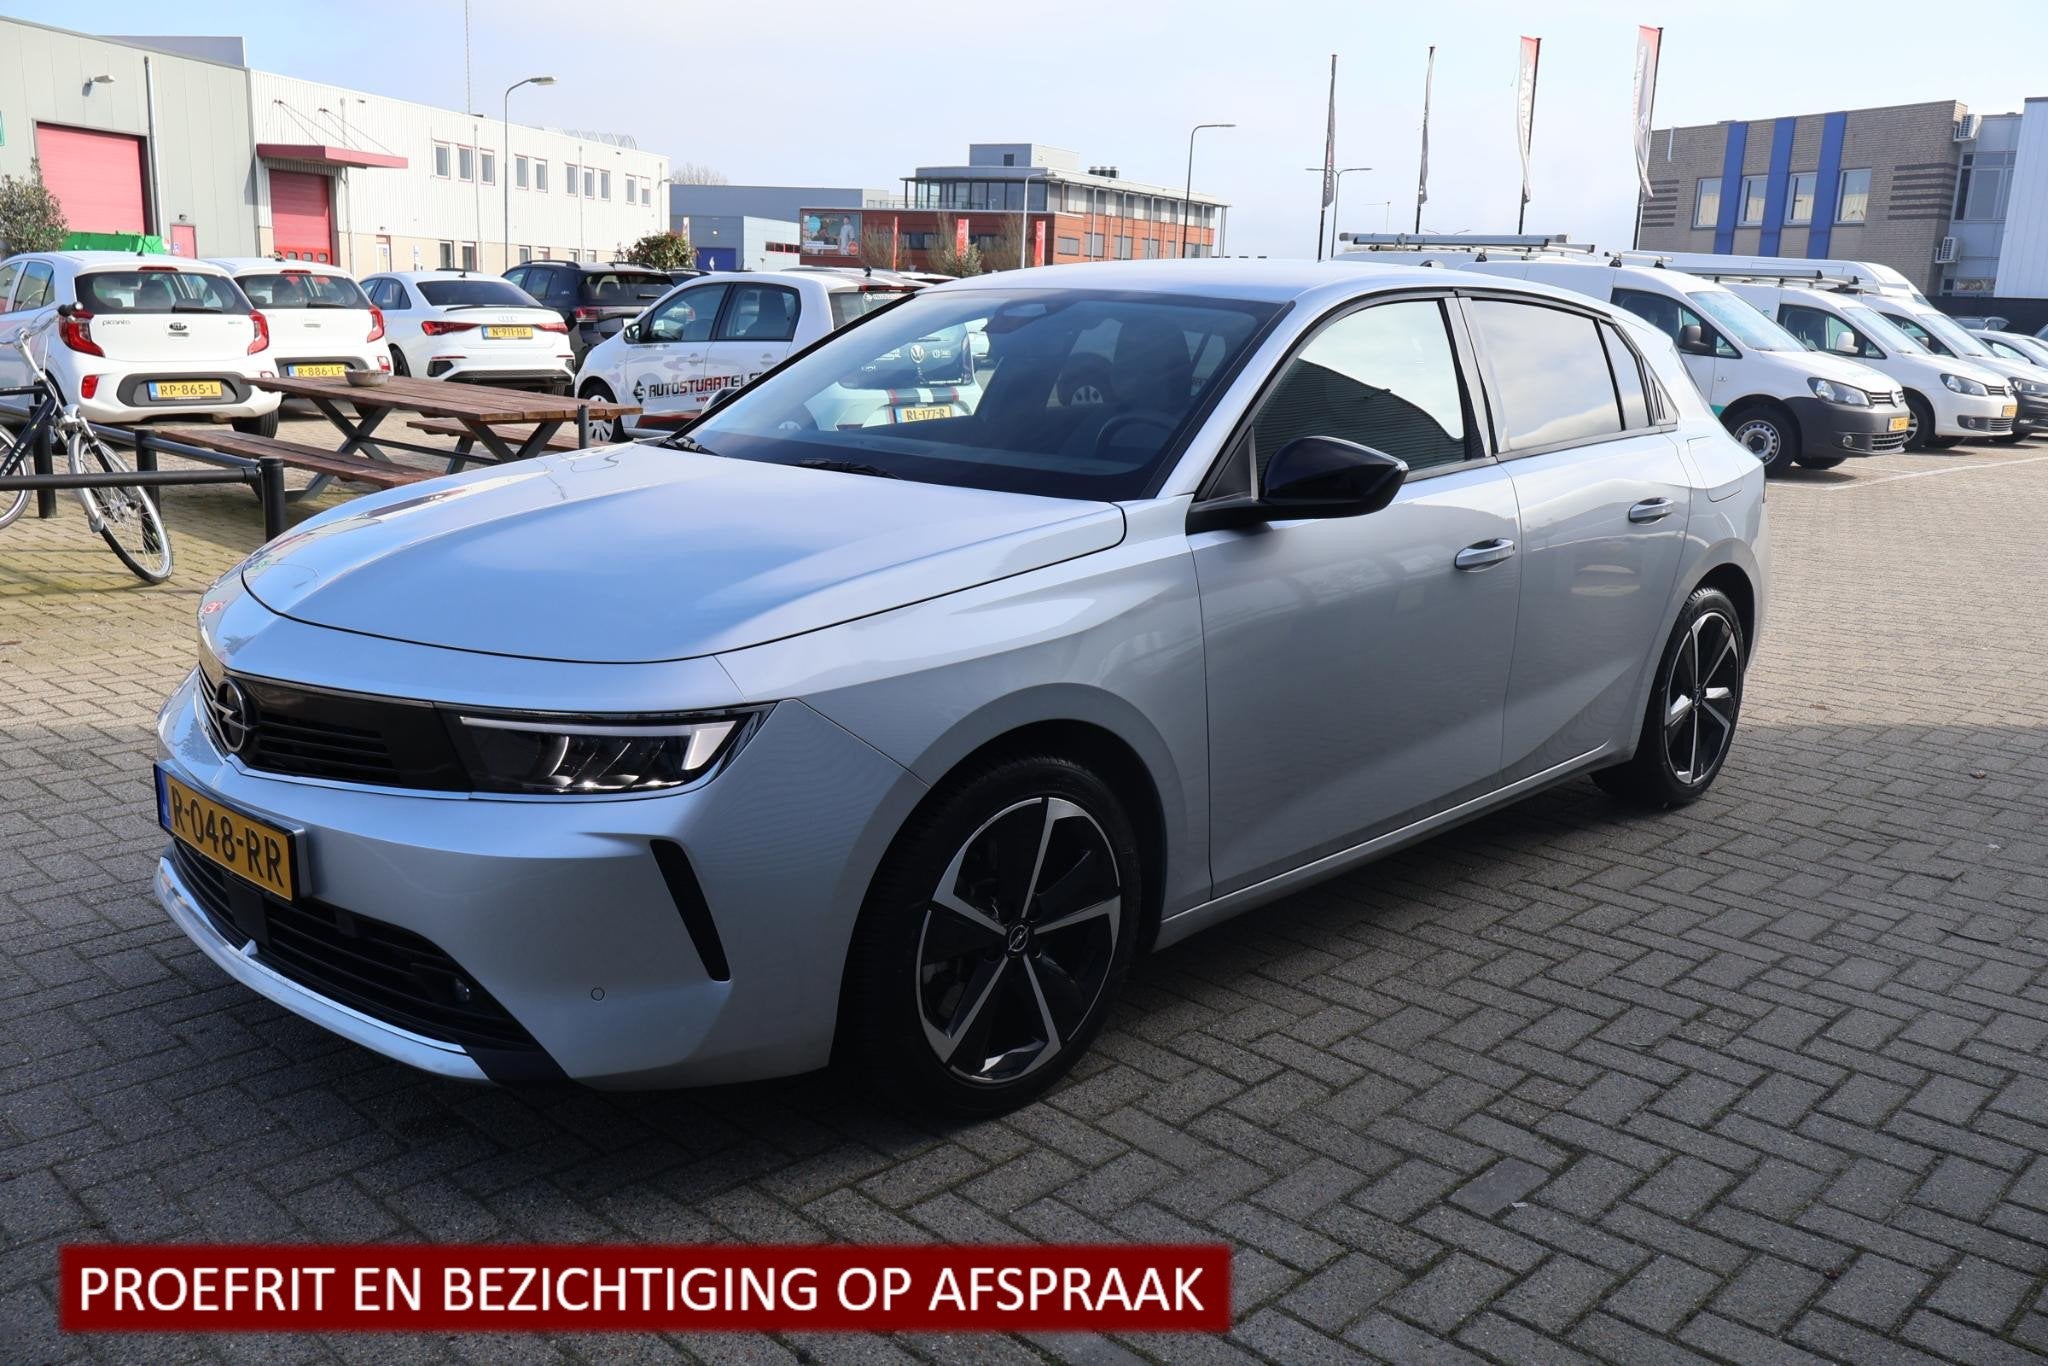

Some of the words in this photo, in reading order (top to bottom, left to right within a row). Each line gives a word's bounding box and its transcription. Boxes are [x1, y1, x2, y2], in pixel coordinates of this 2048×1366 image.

[160, 383, 218, 396] RP-865-L
[906, 407, 945, 421] RL-177-R
[171, 785, 285, 889] R-048-RR
